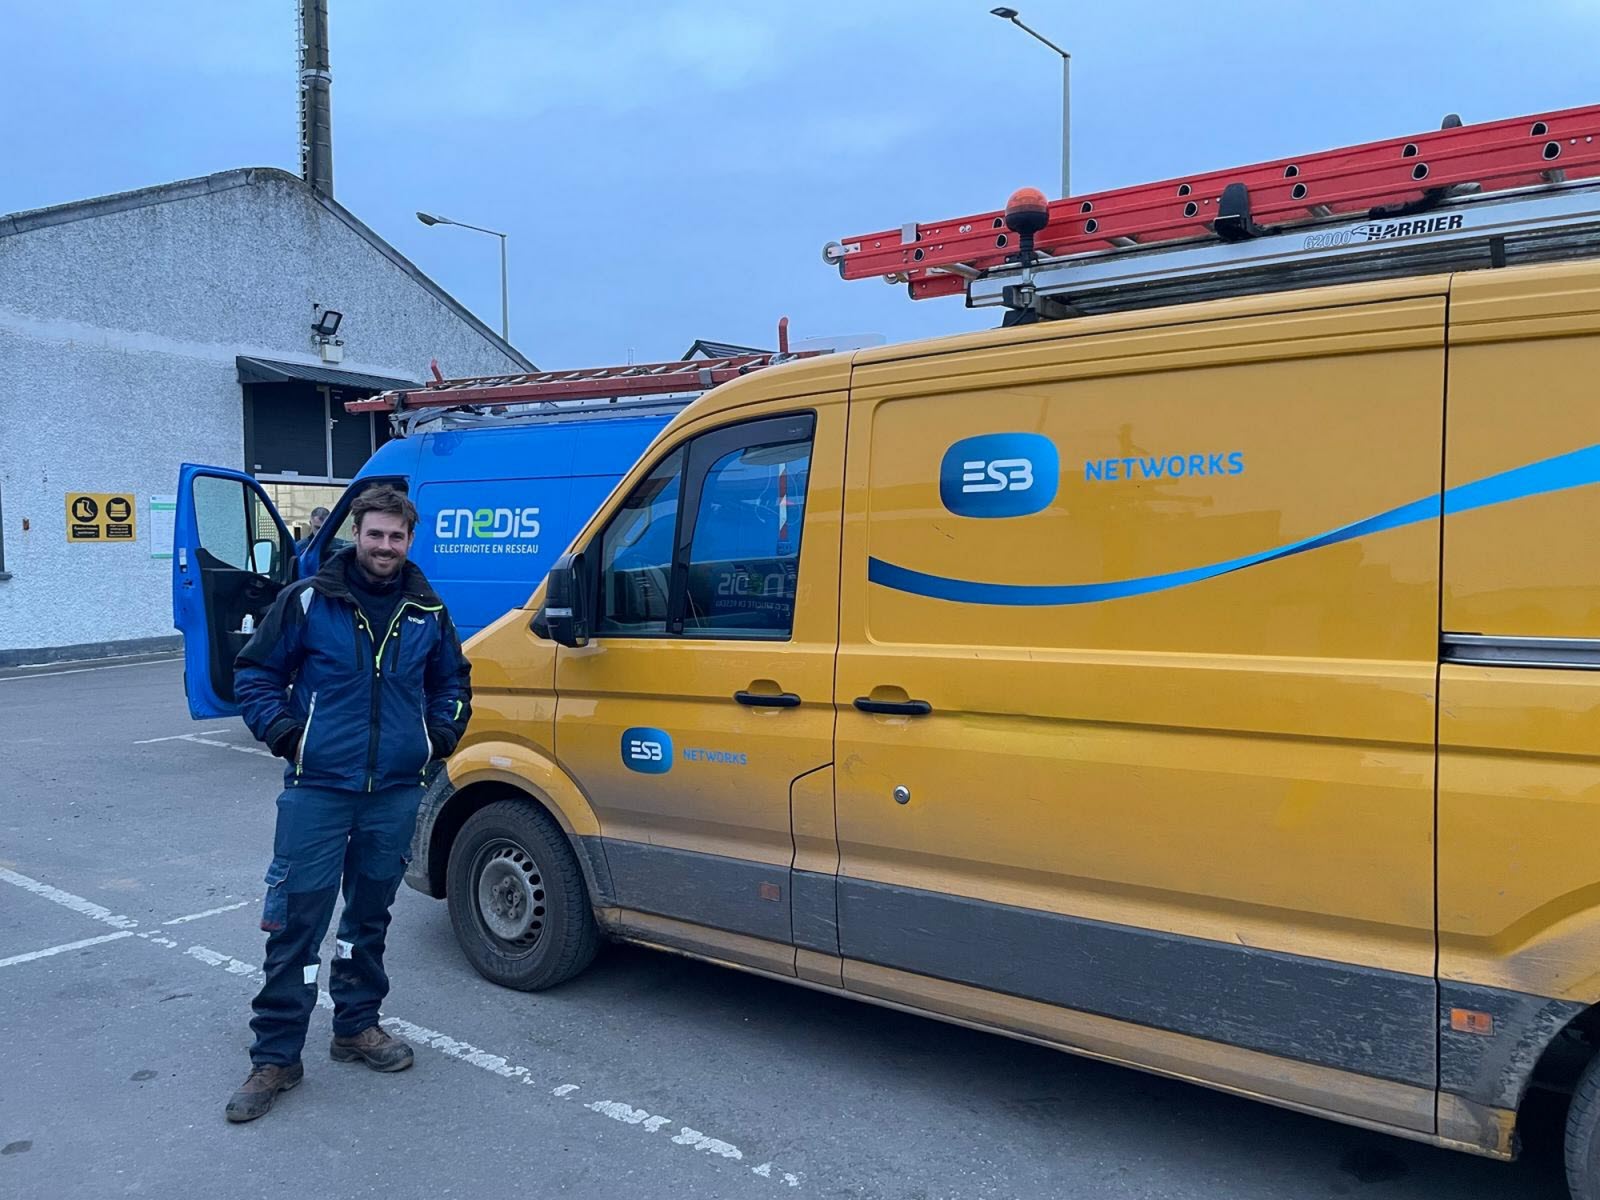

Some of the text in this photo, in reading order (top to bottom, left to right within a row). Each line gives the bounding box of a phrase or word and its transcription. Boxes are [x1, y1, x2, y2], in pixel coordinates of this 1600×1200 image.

[1367, 214, 1464, 241] HARRIER
[962, 452, 1244, 493] ESB NETWORKS
[434, 544, 538, 554] L'ELECTRICITE EN RESEAU
[631, 740, 747, 765] ESB NETWORKS
